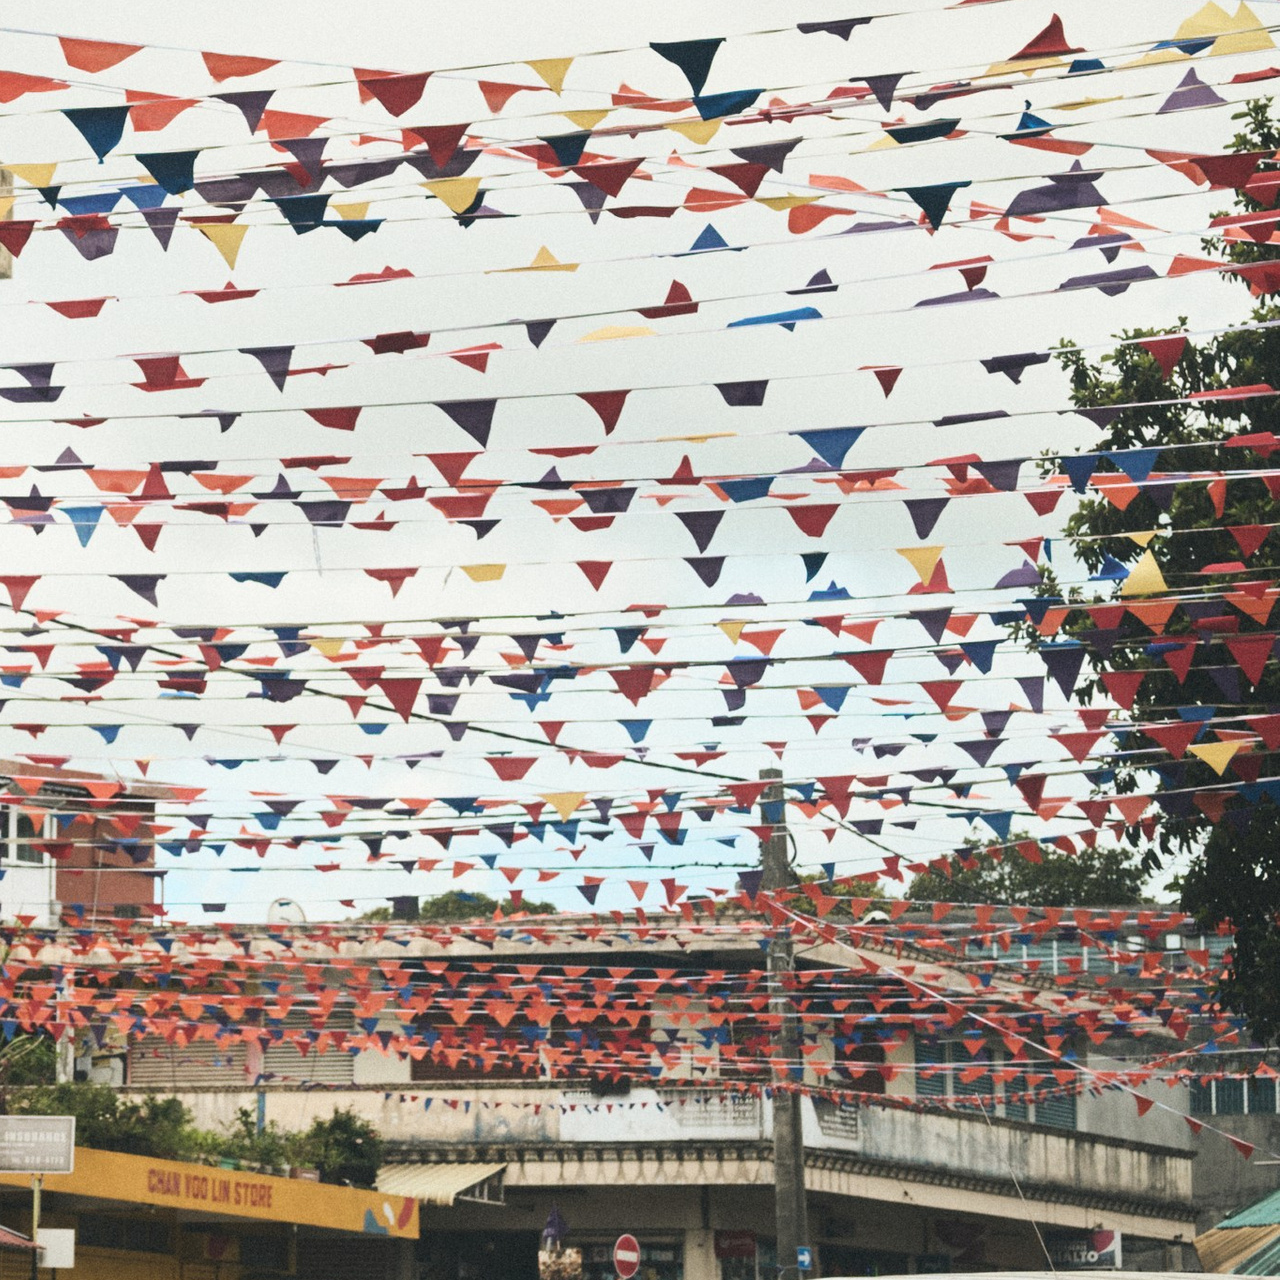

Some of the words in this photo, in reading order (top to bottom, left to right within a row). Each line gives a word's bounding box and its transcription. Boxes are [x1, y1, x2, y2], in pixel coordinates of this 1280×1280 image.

[148, 1168, 181, 1197] CHAN
[211, 1178, 231, 1203] LIN
[235, 1181, 273, 1209] STORE
